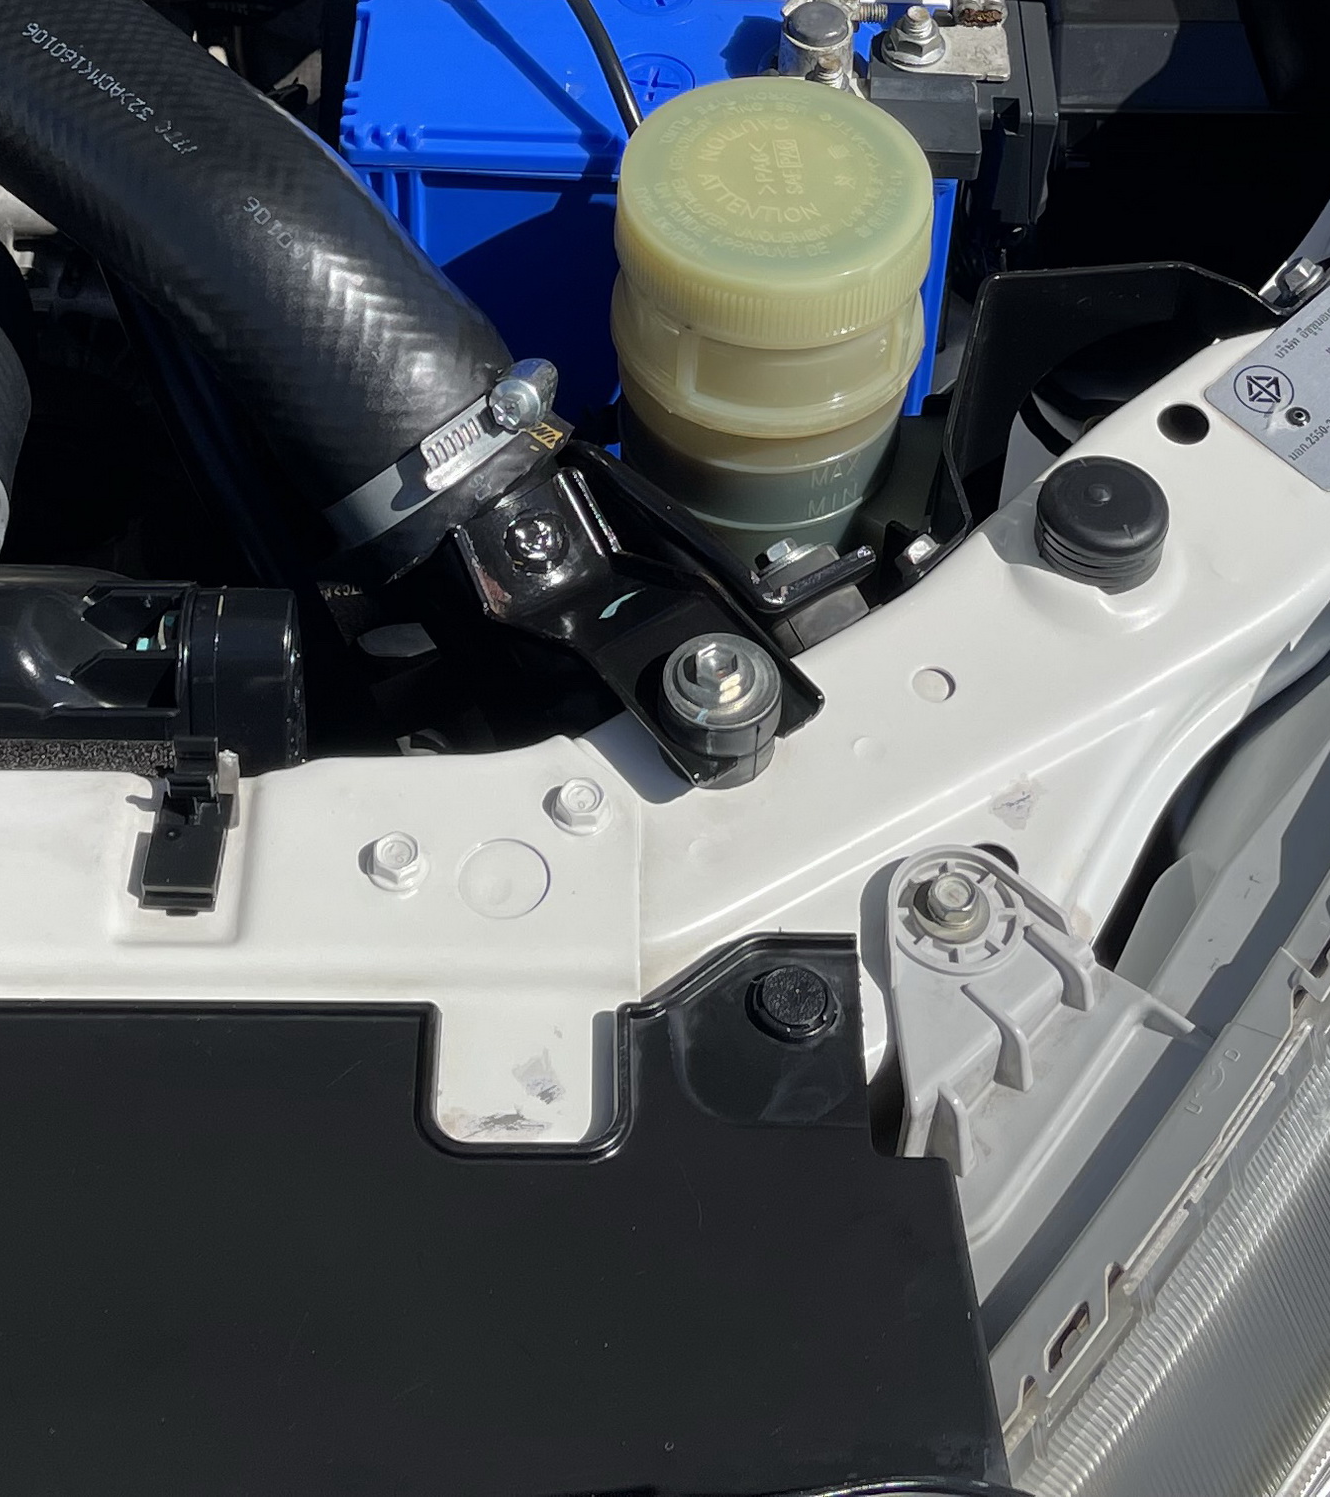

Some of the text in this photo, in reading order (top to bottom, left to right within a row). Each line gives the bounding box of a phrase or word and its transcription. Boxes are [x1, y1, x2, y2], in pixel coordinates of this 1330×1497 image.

[697, 173, 821, 223] ATTENTION
[811, 452, 861, 488] MAX
[808, 482, 858, 518] MIN
